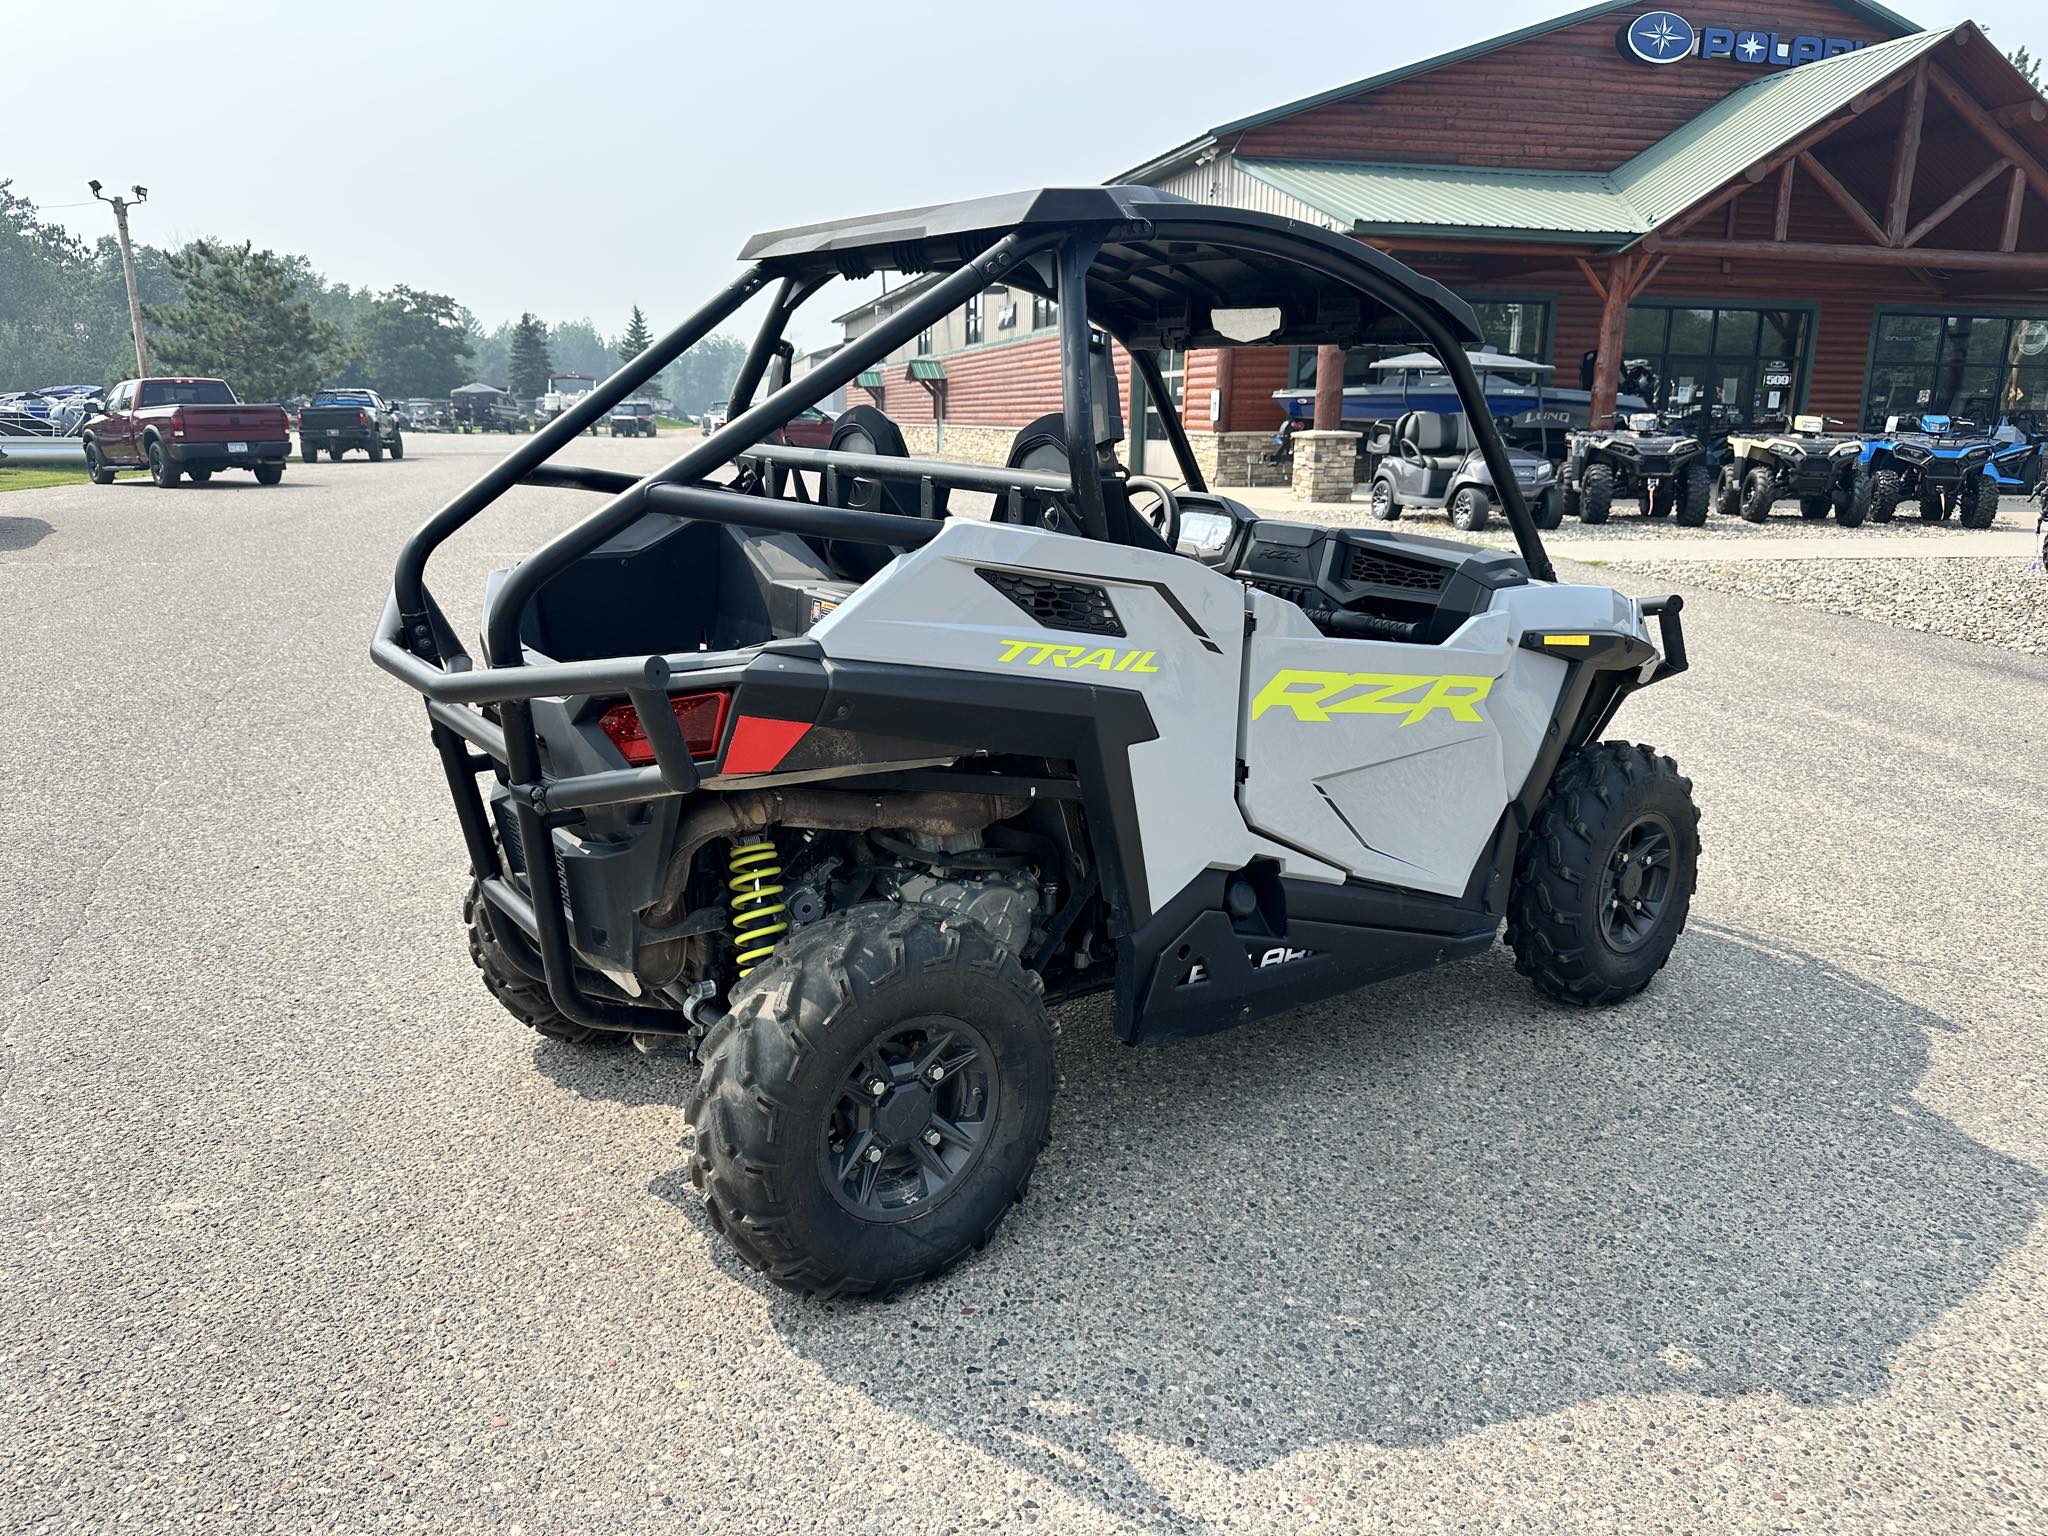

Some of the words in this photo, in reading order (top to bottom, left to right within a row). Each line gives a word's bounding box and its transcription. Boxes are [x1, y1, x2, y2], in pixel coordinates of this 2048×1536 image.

[1702, 28, 1877, 66] POLAR
[1766, 375, 1789, 386] 509
[997, 639, 1160, 673] TRAIL
[1252, 669, 1494, 728] RZR
